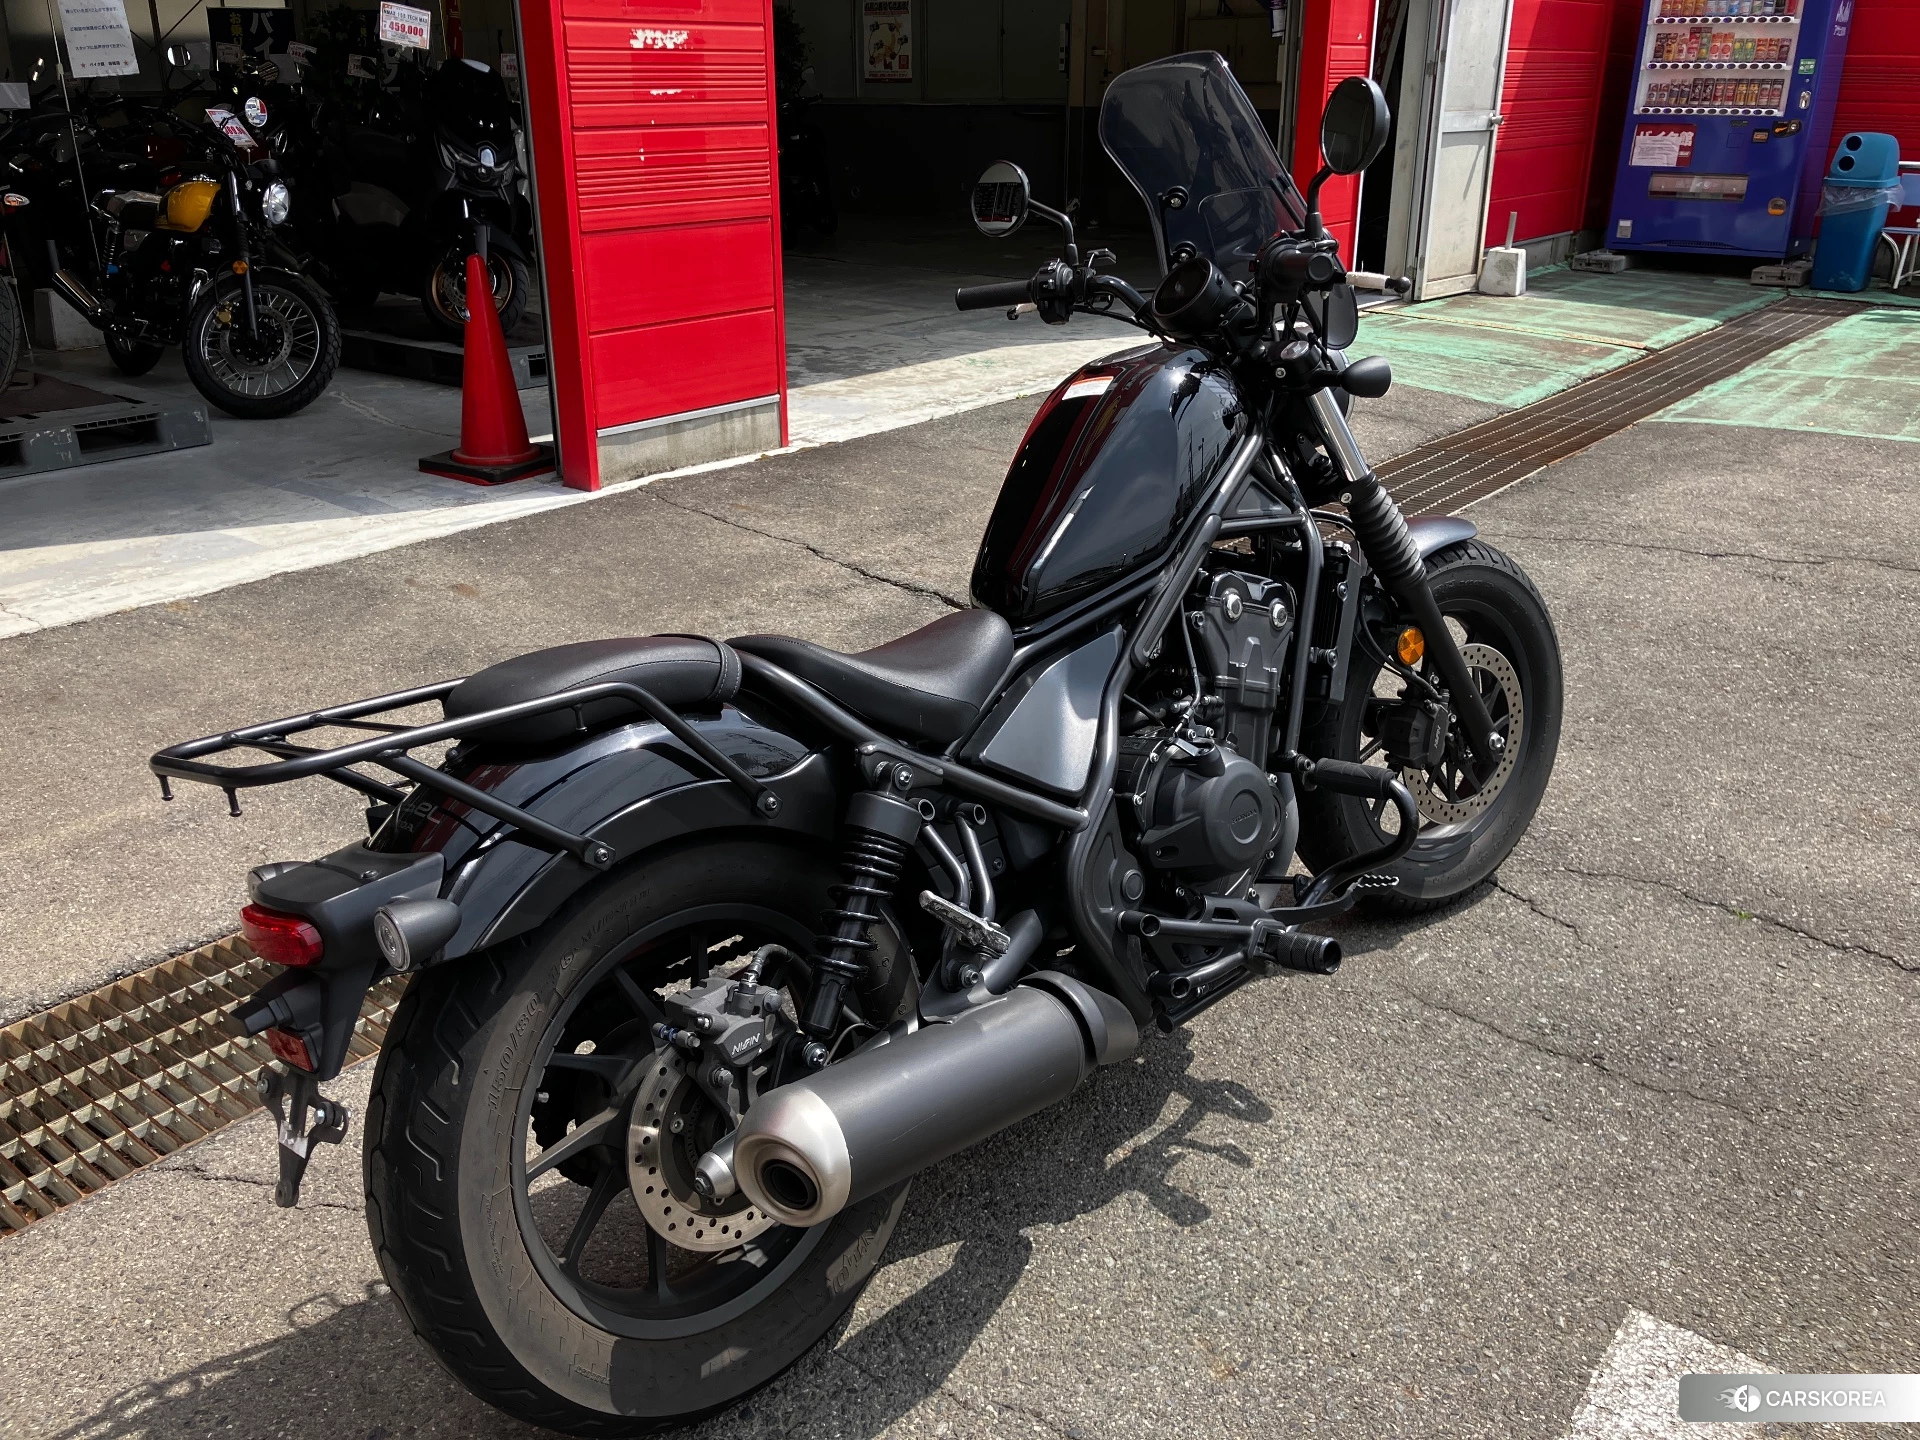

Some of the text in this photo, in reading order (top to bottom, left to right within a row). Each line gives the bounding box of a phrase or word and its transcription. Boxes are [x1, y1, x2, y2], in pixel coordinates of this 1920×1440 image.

[407, 14, 419, 22] TECH
[389, 21, 424, 37] 459,000
[1212, 401, 1244, 420] HONDA
[1231, 808, 1258, 825] HONDA
[731, 1032, 761, 1056] NISSIN
